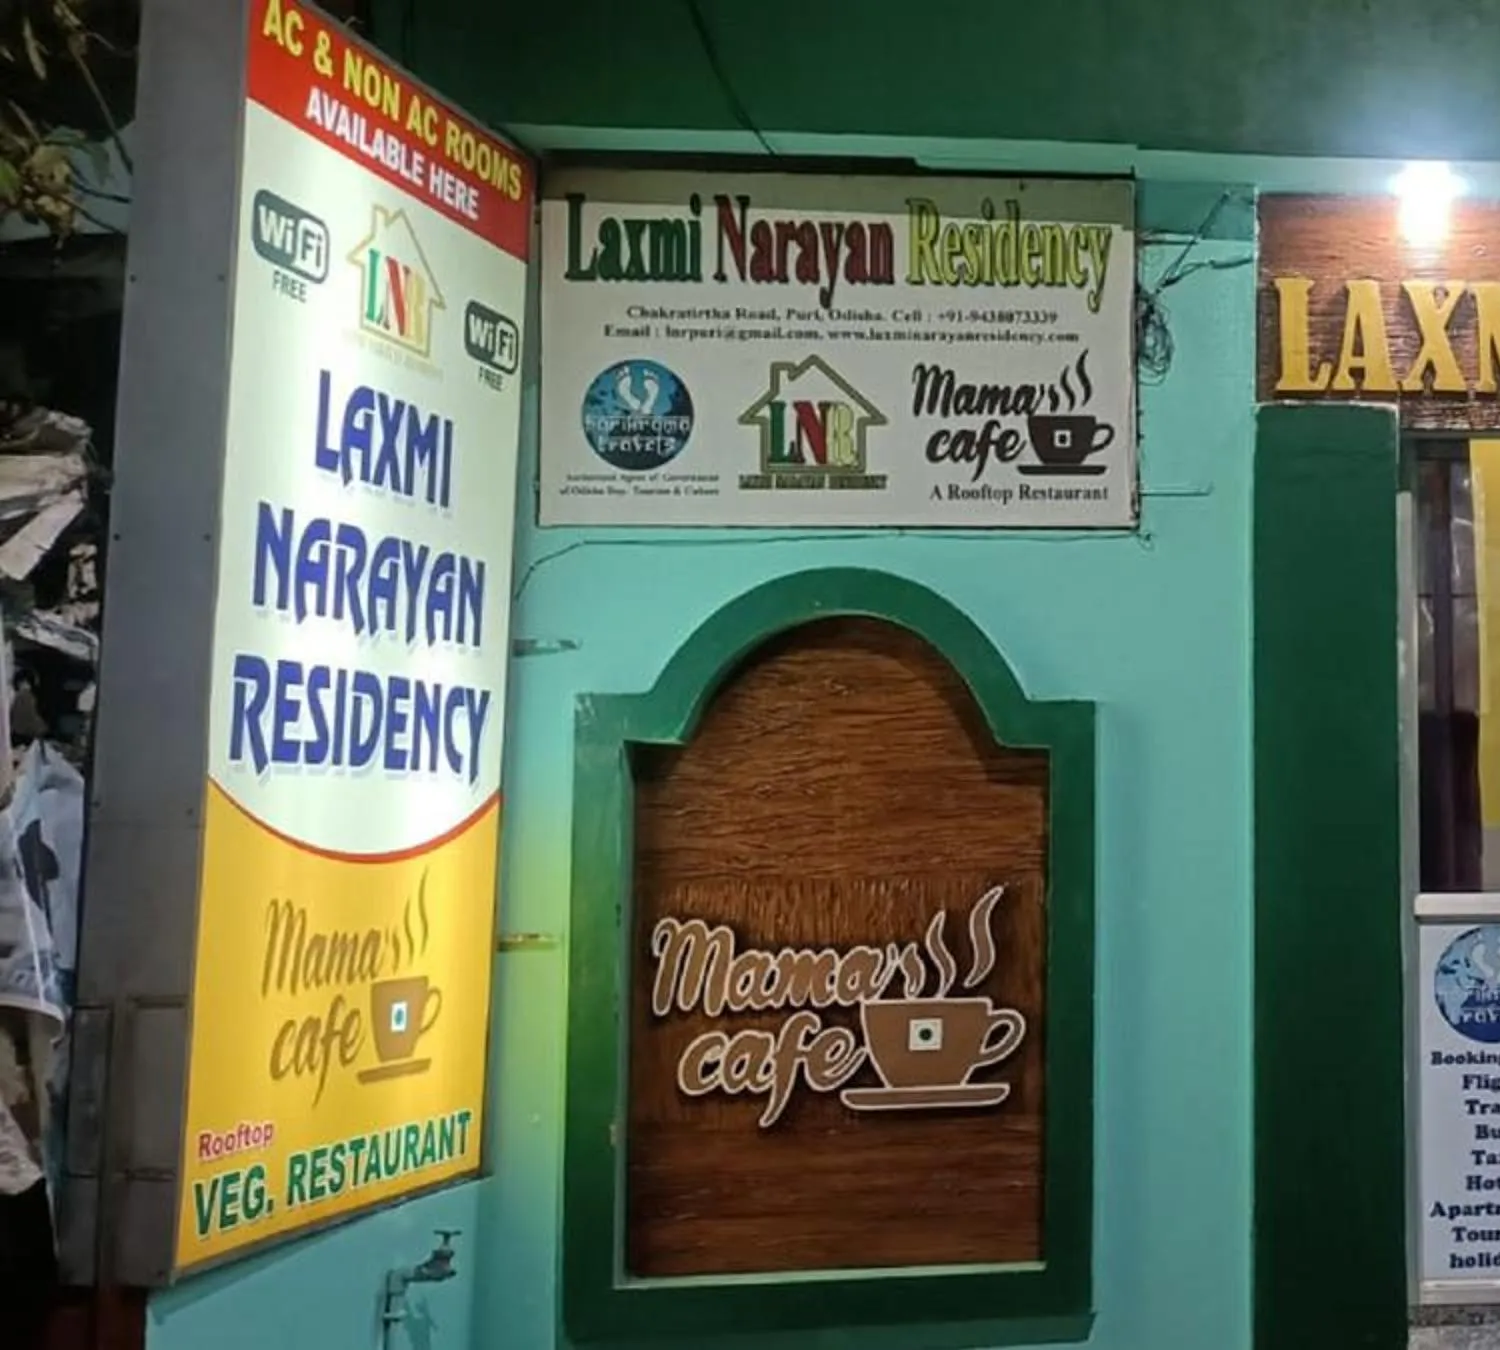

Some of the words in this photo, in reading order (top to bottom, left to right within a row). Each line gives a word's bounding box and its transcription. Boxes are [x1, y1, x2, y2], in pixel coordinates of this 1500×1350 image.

[263, 0, 305, 57] AC
[313, 30, 334, 77] &
[343, 48, 401, 121] NON
[405, 95, 439, 146] AC
[445, 119, 522, 200] ROOMS
[306, 86, 424, 187] AVAILABLE
[429, 164, 480, 220] HERE
[272, 270, 308, 304] FREE
[564, 192, 703, 283] Laxmi
[713, 193, 895, 310] Narayan
[905, 197, 1112, 314] Residency
[478, 365, 504, 392] FREE
[604, 323, 650, 338] Email
[315, 369, 455, 508] LAXMI
[768, 400, 860, 468] LNR
[925, 419, 1028, 483] cafe
[929, 485, 943, 501] A
[948, 484, 1013, 505] Rooftop
[1018, 485, 1109, 502] Restaurant
[252, 501, 486, 647] NARAYAN
[228, 654, 491, 785] RESIDENCY
[270, 995, 367, 1109] cafe
[677, 1011, 868, 1128] cafe
[193, 1164, 274, 1236] VEG.
[286, 1111, 471, 1206] RESTAURANT
[198, 1122, 275, 1159] Rooftop
